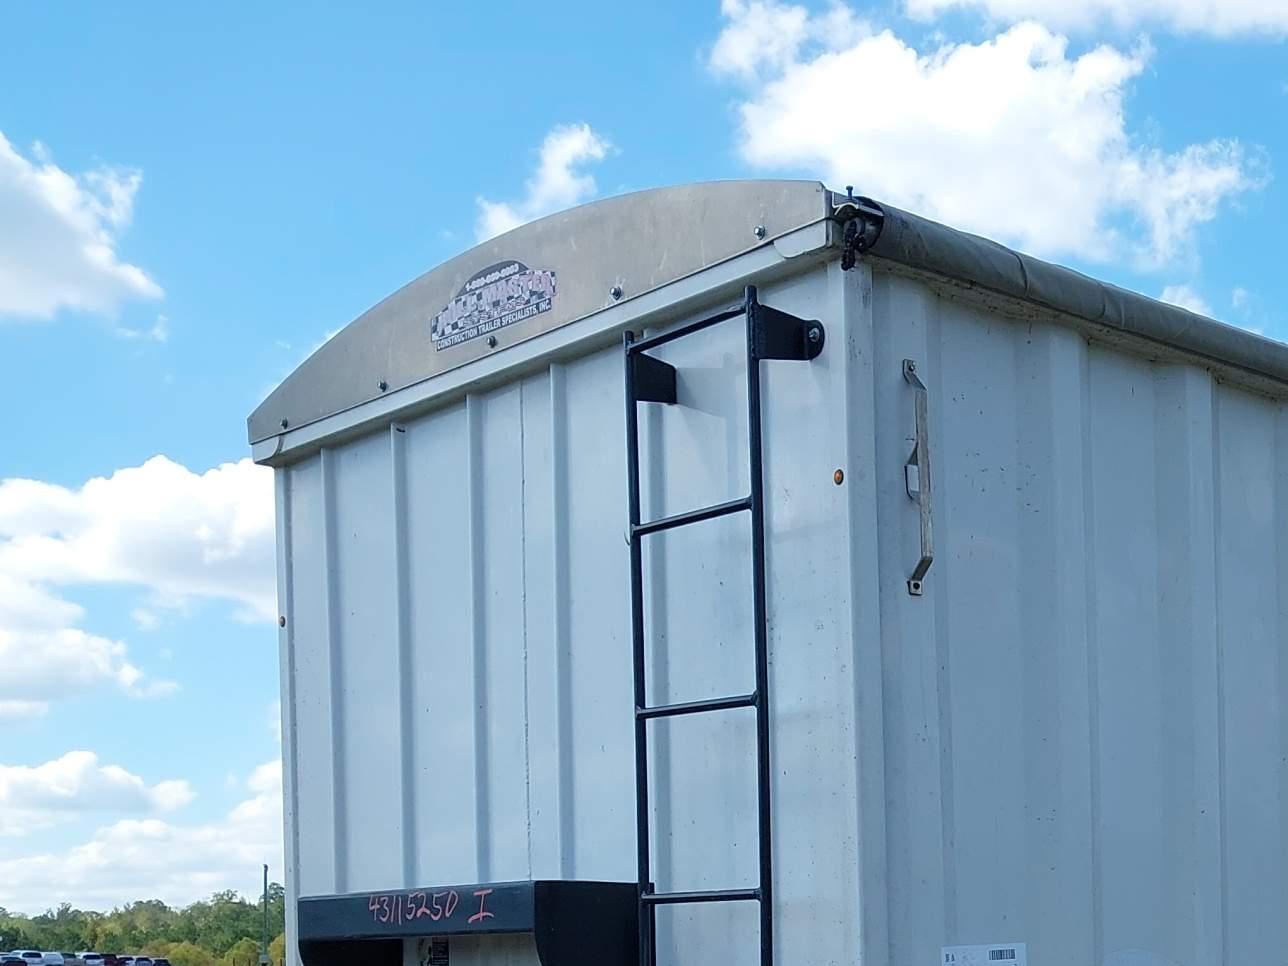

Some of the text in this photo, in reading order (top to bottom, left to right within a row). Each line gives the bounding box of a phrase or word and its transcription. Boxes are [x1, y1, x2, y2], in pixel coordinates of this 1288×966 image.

[437, 326, 478, 349] CONSTRUCTION
[478, 318, 501, 338] TRAILER
[538, 299, 551, 314] INC.
[368, 890, 459, 925] 43115250
